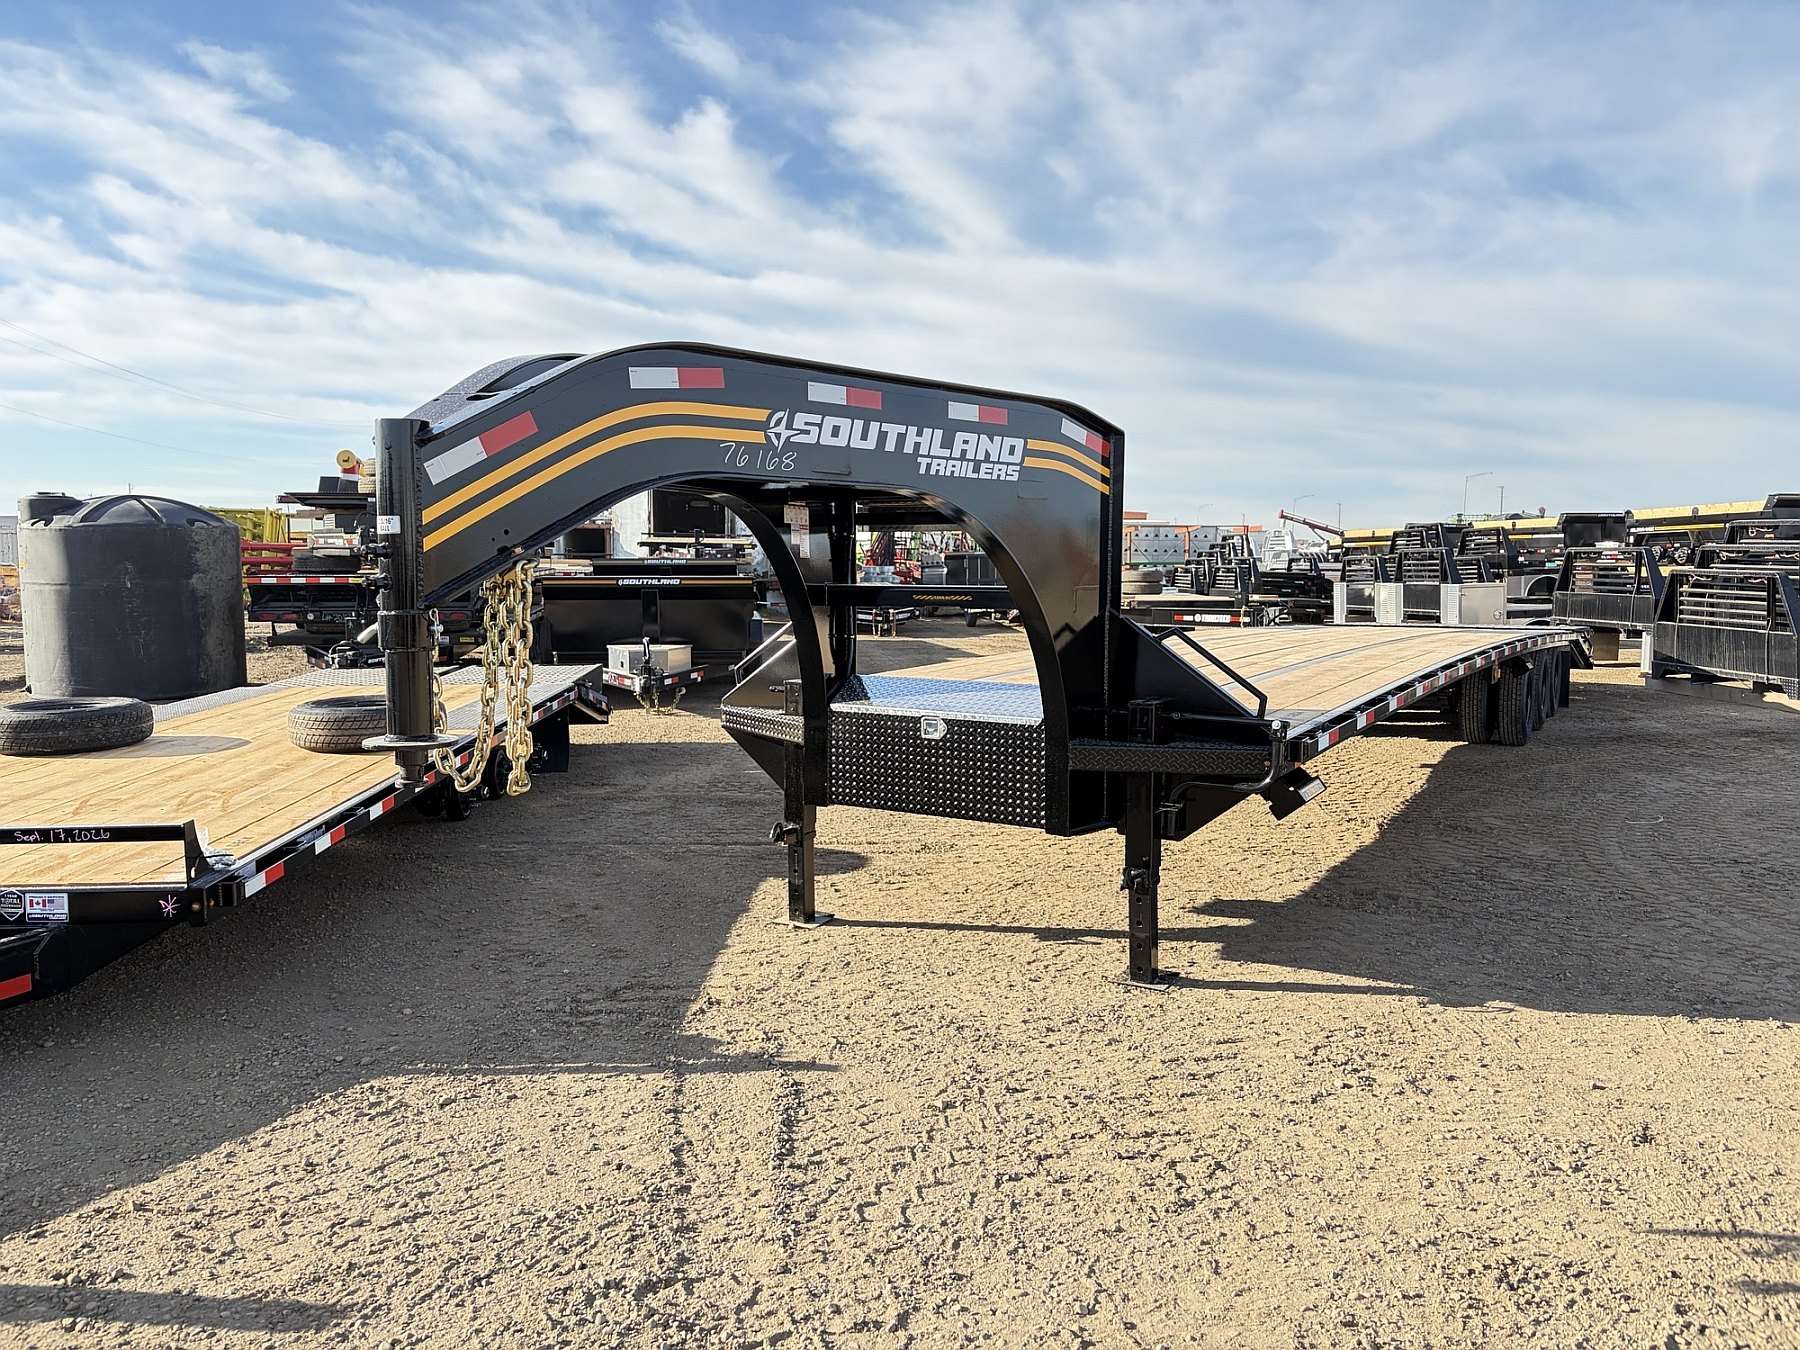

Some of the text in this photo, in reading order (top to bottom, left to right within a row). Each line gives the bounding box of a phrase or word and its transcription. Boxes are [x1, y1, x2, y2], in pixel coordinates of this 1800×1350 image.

[790, 411, 1025, 464] SOUTHLAND
[719, 441, 797, 472] 76168
[917, 457, 1020, 481] TRAILERS
